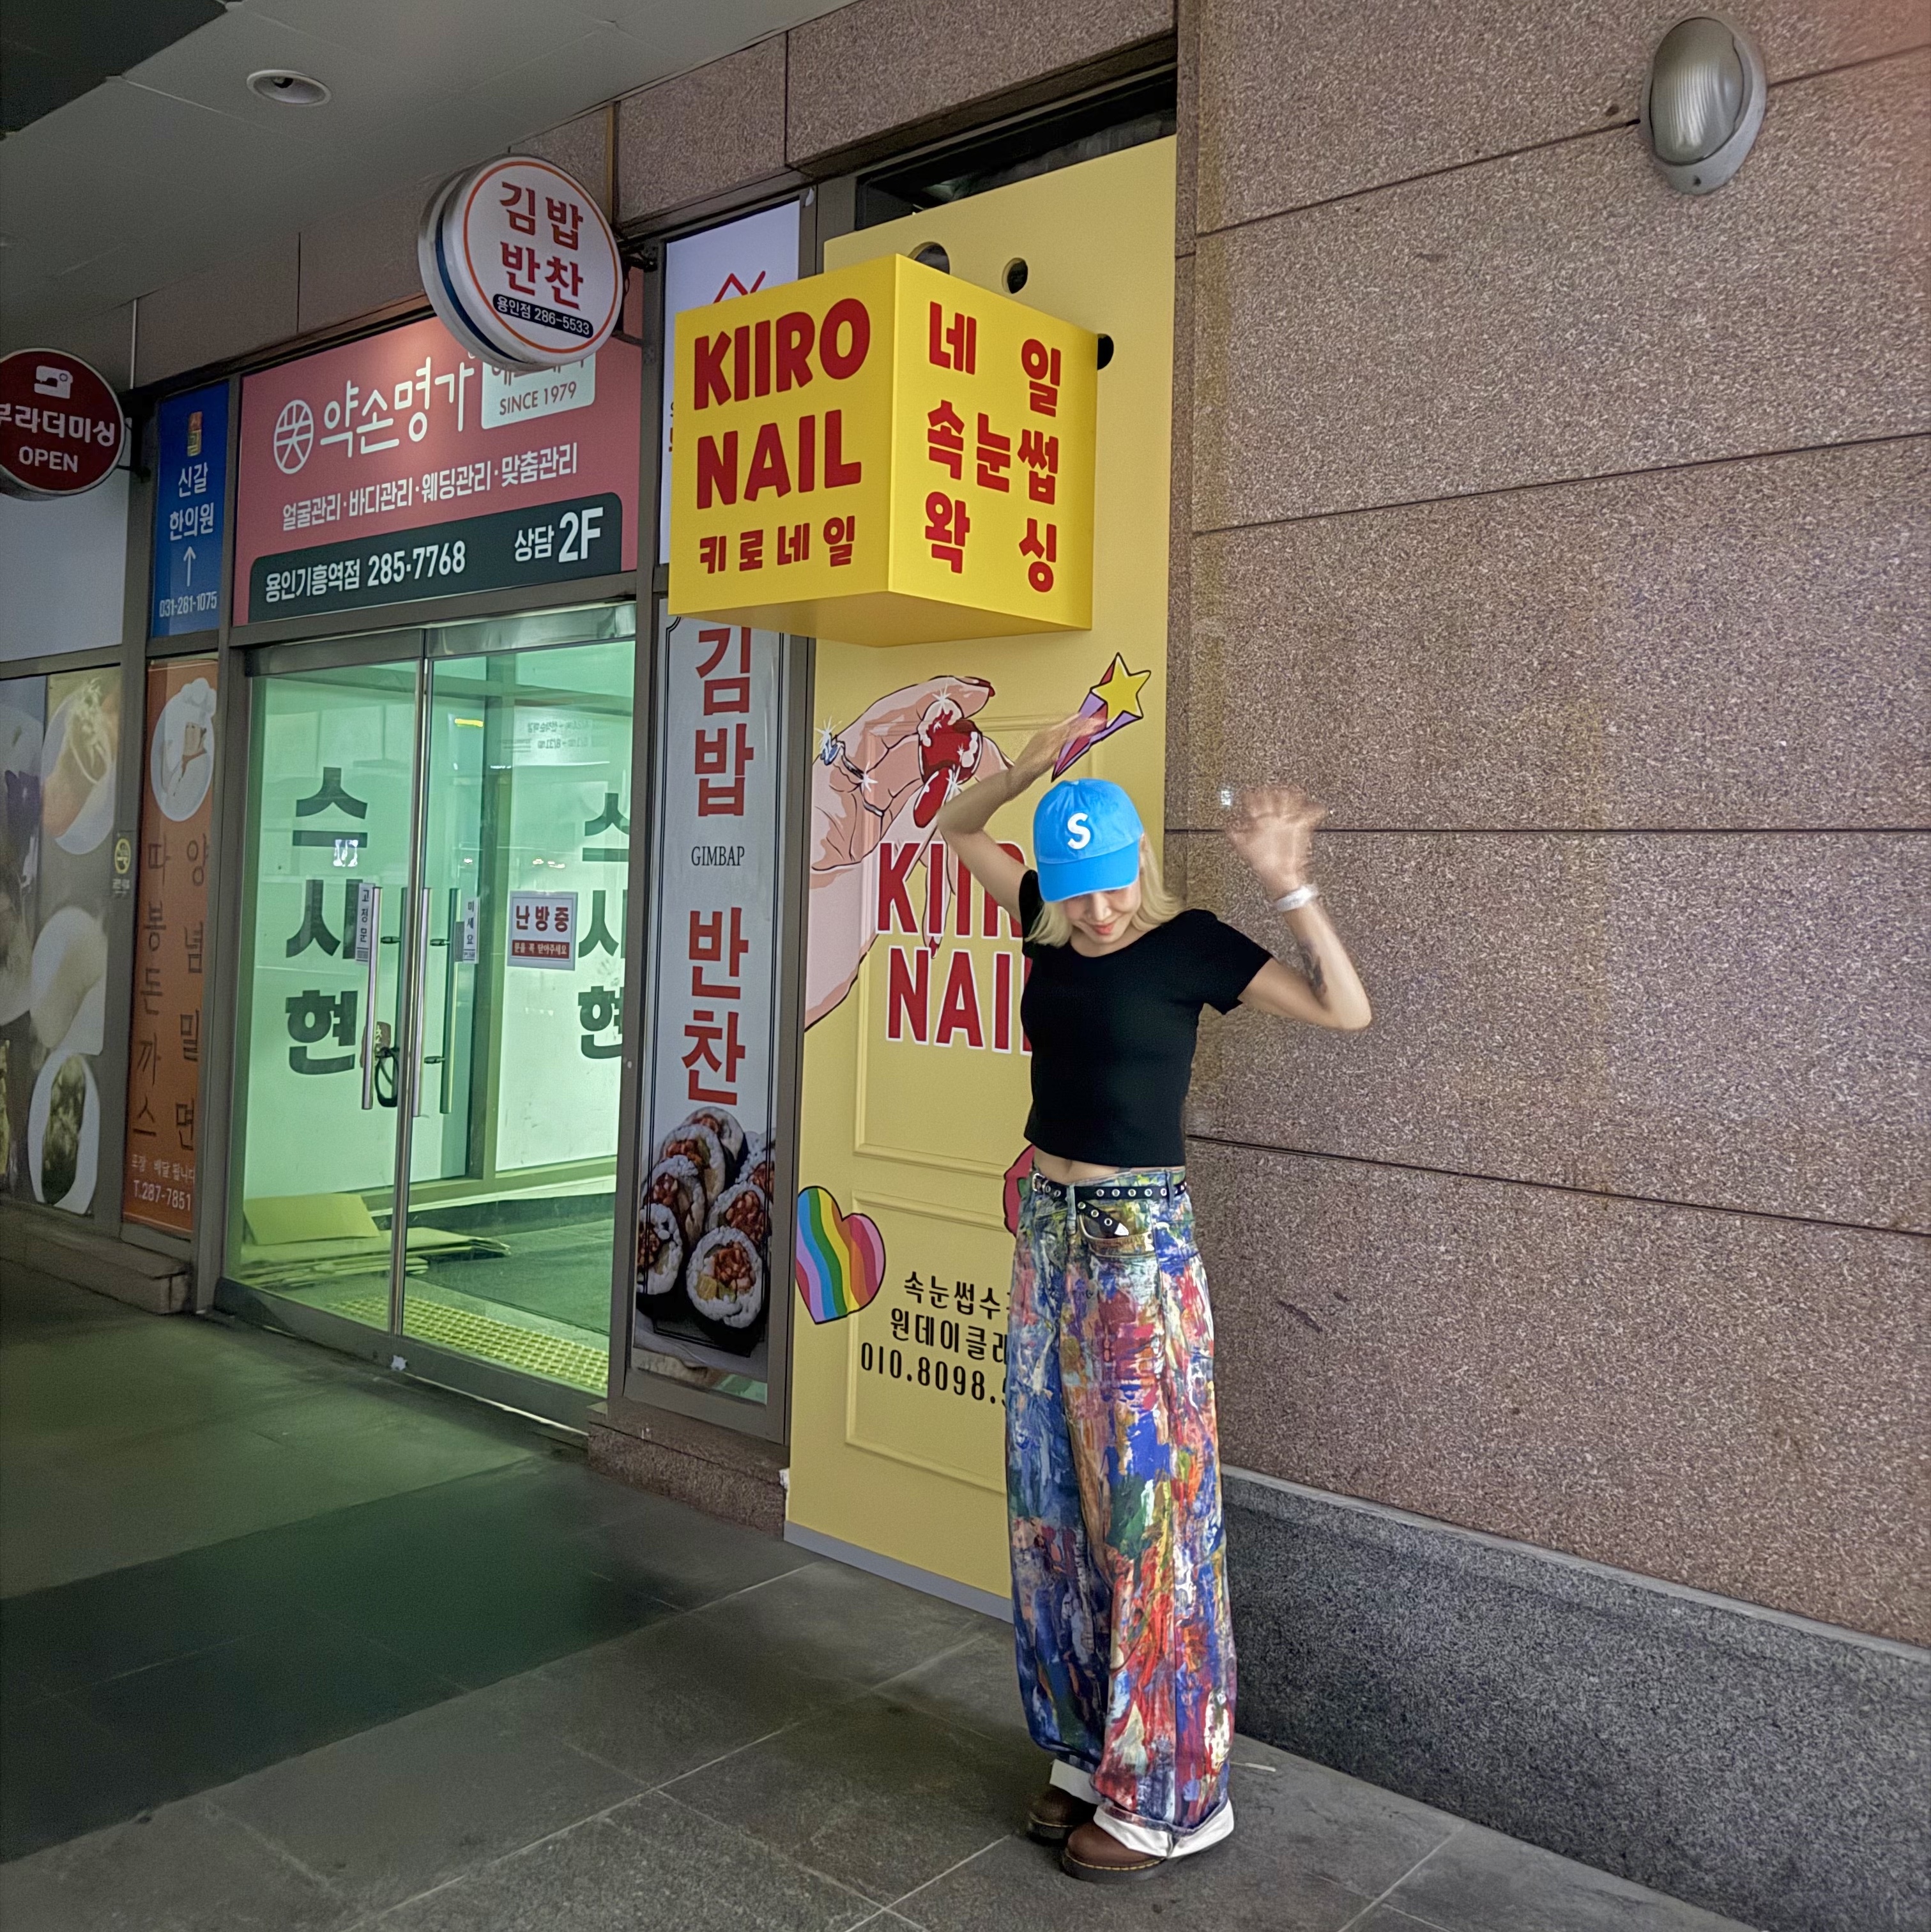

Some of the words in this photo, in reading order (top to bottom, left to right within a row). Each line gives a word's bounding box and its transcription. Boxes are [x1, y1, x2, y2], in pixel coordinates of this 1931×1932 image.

[500, 181, 583, 251] 김밥
[500, 241, 583, 311] 반찬
[497, 295, 531, 320] 용인점
[535, 307, 590, 336] 286-5533
[694, 298, 870, 411] KIIRO
[929, 301, 1061, 417] 네일
[320, 356, 475, 458] 약손명가
[500, 391, 538, 416] SINCE
[544, 381, 577, 405] 1979
[19, 446, 78, 473] OPEN
[696, 409, 862, 509] NAIL
[927, 399, 1058, 505] 속눈썹
[178, 462, 208, 497] 신갈
[169, 502, 215, 541] 한의원
[515, 526, 554, 563] 상담
[558, 507, 604, 563] 2F
[925, 491, 1057, 592] 왁싱
[159, 591, 217, 618] 031-281-1075
[265, 559, 360, 603] 용인기흥역점
[694, 627, 754, 817] 김밥
[691, 846, 745, 867] GIMBAP
[1067, 812, 1091, 849] S
[360, 888, 370, 943] 고정문
[516, 906, 569, 932] 난방중
[515, 943, 525, 953] 문을
[529, 943, 535, 954] 꼭
[538, 944, 567, 955] 닫아주세요
[681, 906, 750, 1107] 반찬
[904, 1271, 1011, 1320] 속눈썹수
